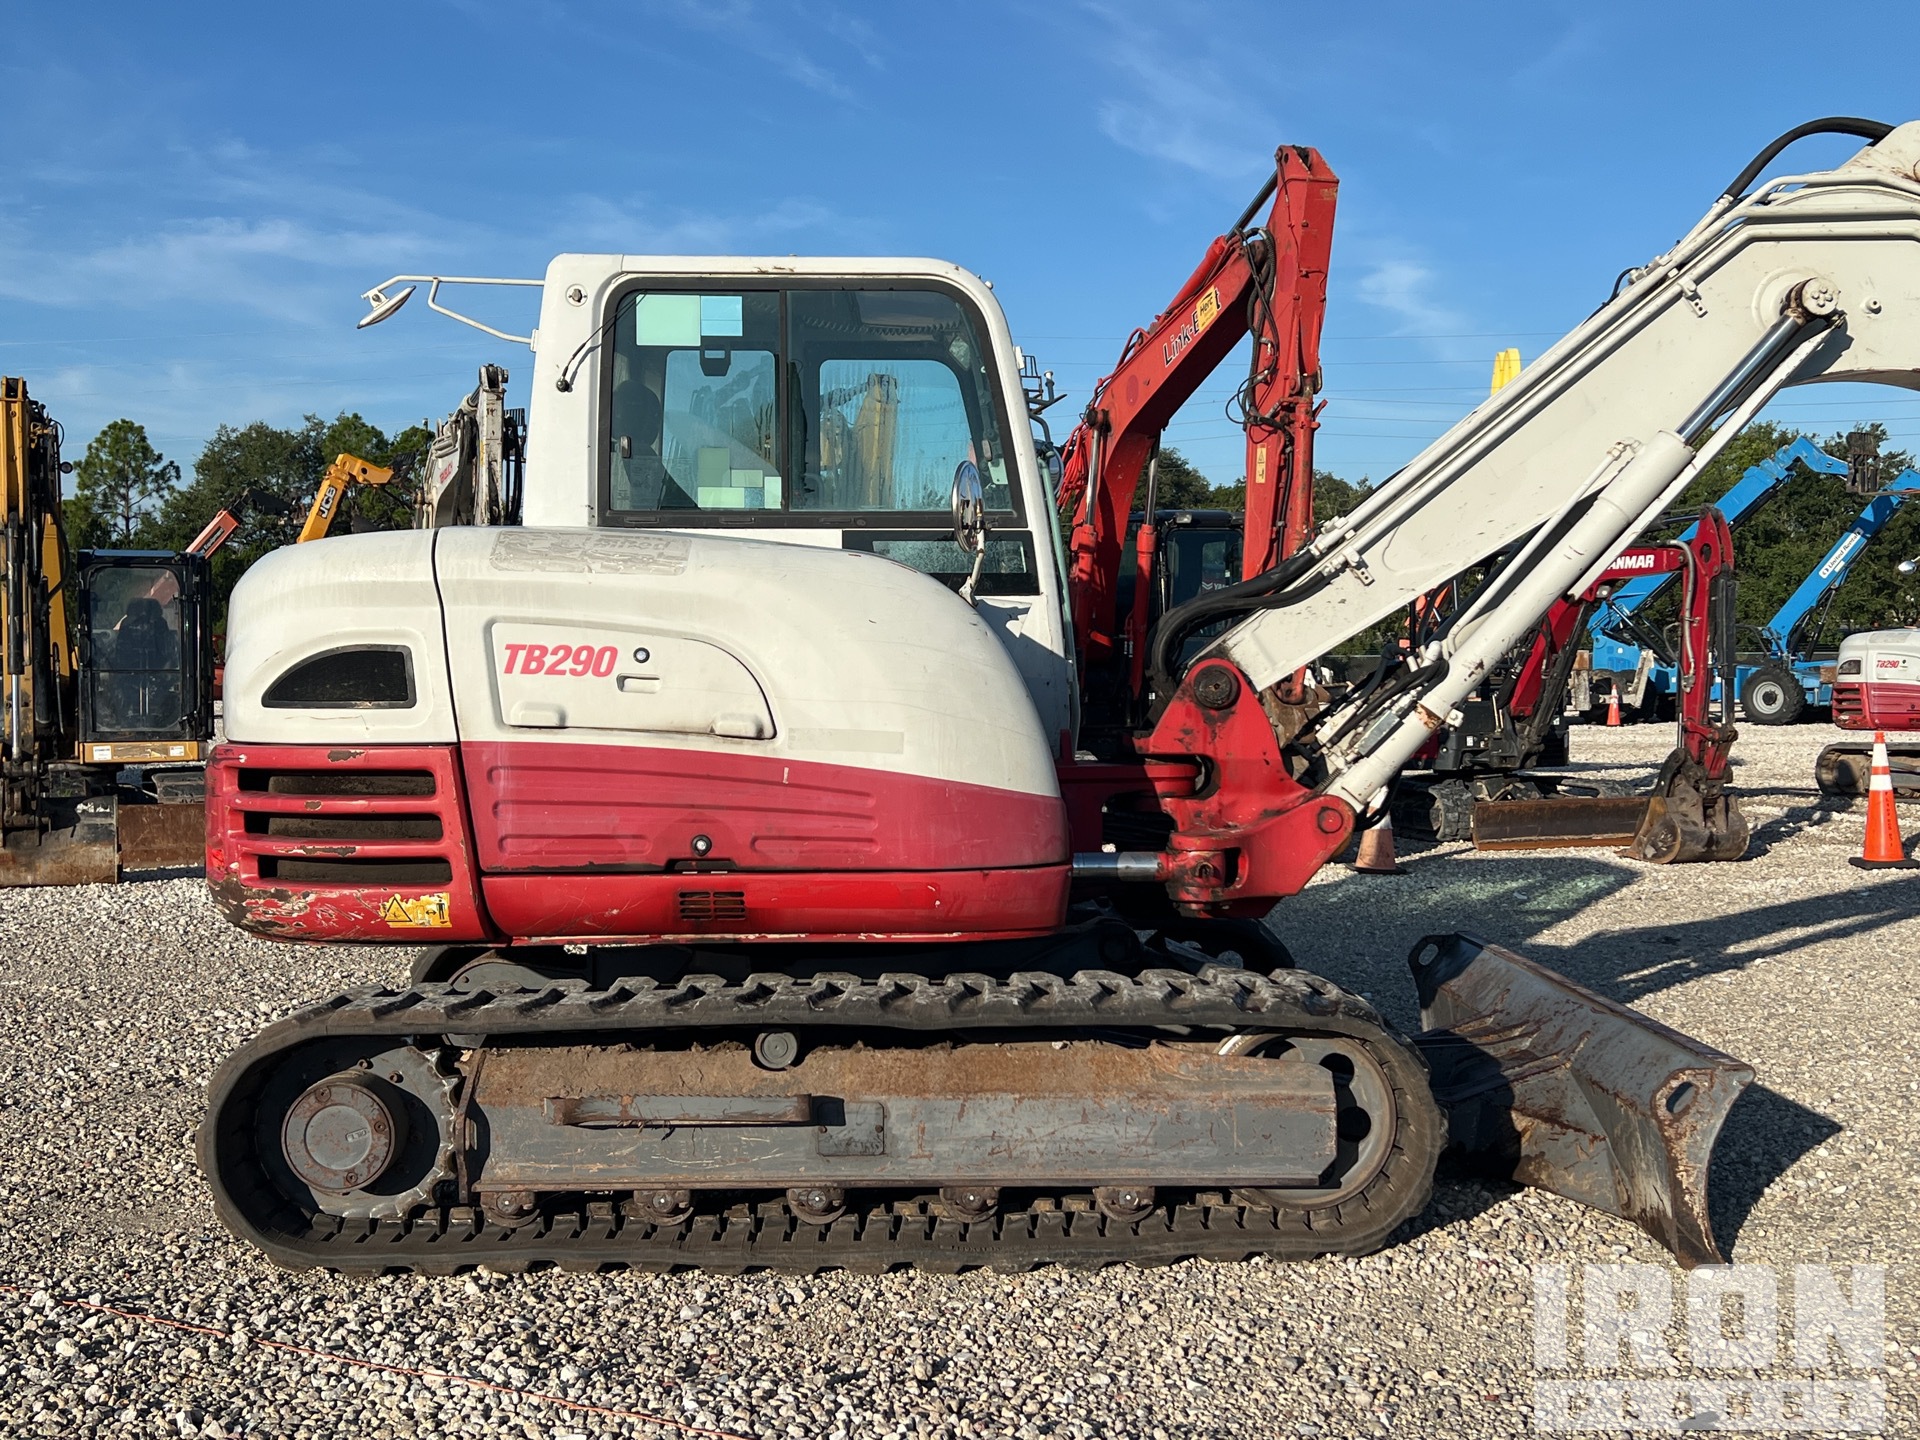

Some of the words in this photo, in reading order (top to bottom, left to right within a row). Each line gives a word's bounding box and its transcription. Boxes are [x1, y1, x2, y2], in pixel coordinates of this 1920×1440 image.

[319, 486, 336, 518] JCB
[1607, 554, 1655, 570] ANMAR
[1828, 550, 1845, 568] United
[504, 643, 618, 677] TB290
[1876, 660, 1900, 669] TB290
